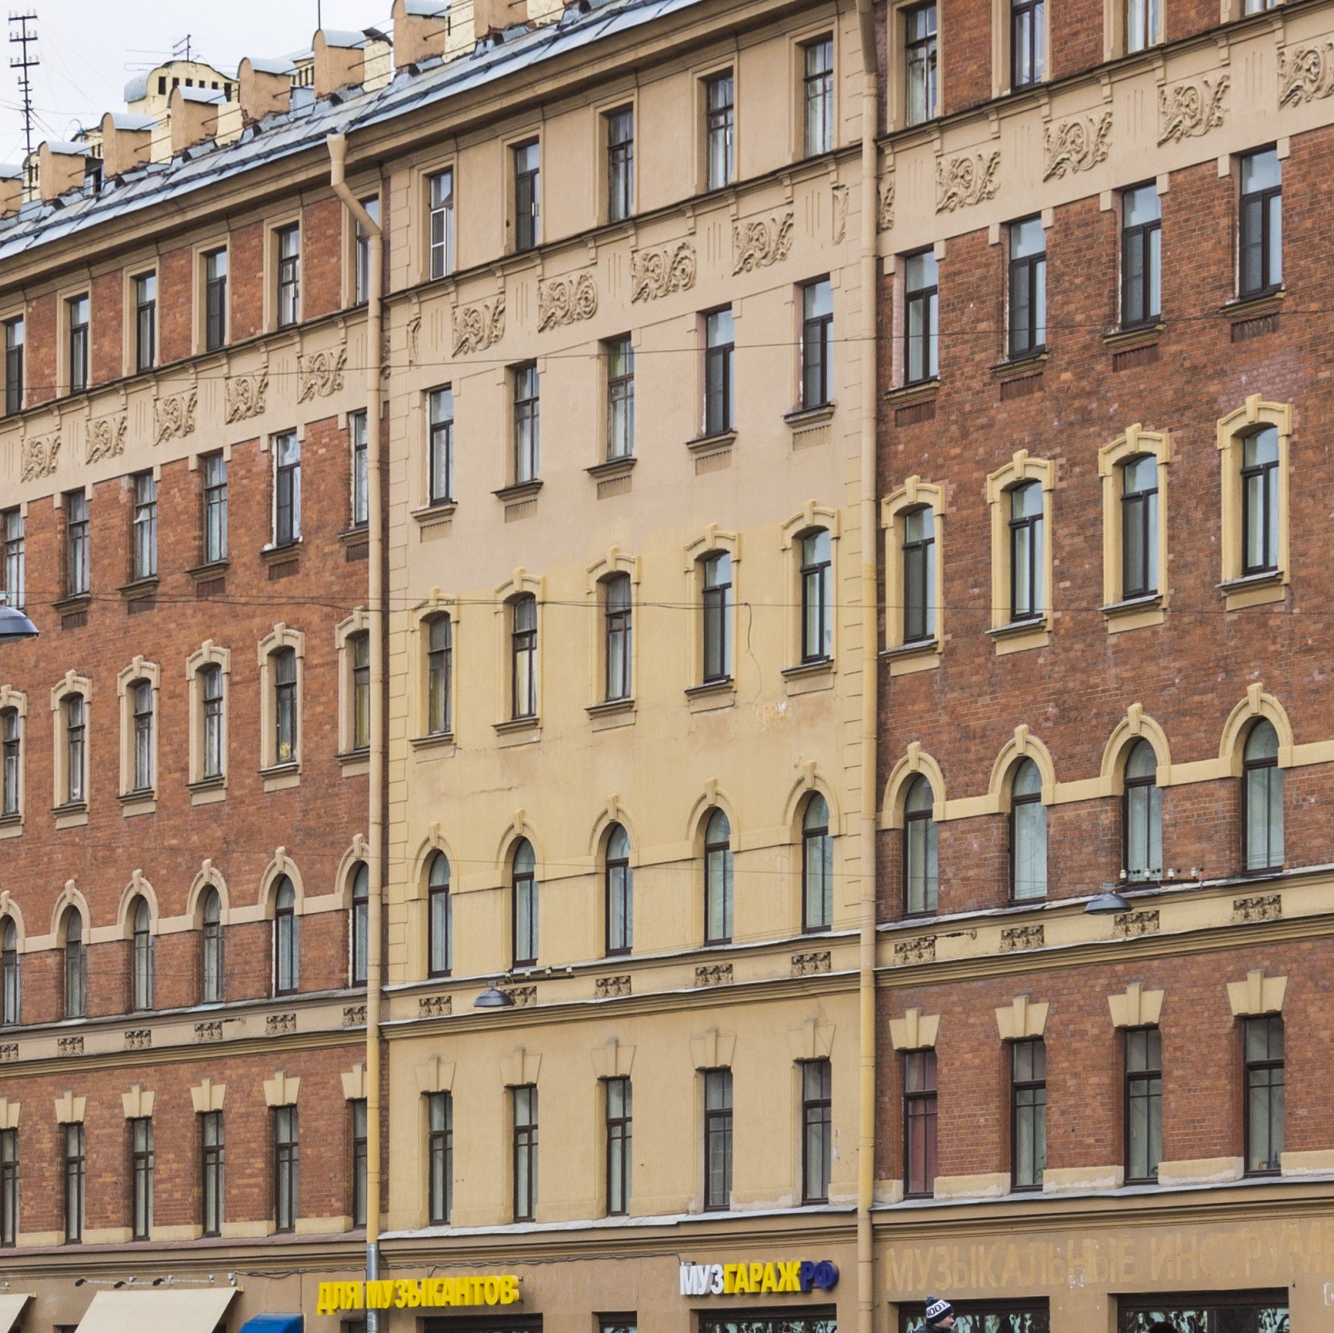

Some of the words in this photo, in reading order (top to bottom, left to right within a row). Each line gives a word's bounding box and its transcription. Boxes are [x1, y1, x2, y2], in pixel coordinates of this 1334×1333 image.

[885, 1236, 1135, 1292] МУЗЫКАЛЬНЫЕ
[317, 1281, 363, 1315] ДЛЯ
[366, 1275, 520, 1309] МУЗЫКАНТОВ
